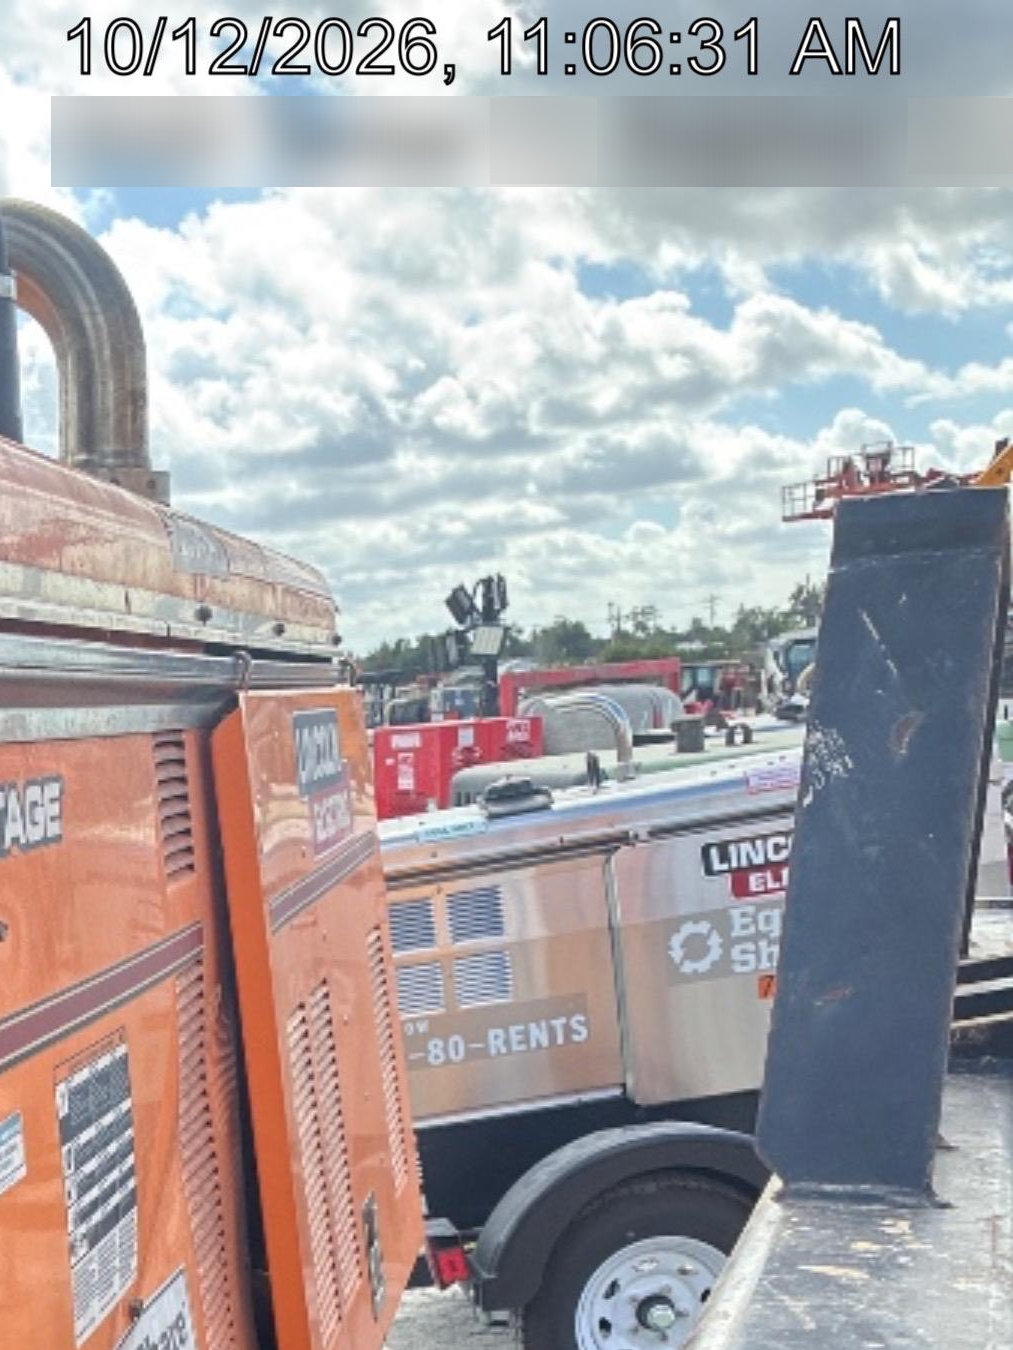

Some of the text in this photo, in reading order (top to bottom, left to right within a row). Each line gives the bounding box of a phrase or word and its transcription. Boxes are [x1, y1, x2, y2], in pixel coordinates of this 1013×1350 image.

[729, 905, 782, 938] Eq
[730, 938, 780, 974] Sh
[404, 1019, 429, 1036] OW
